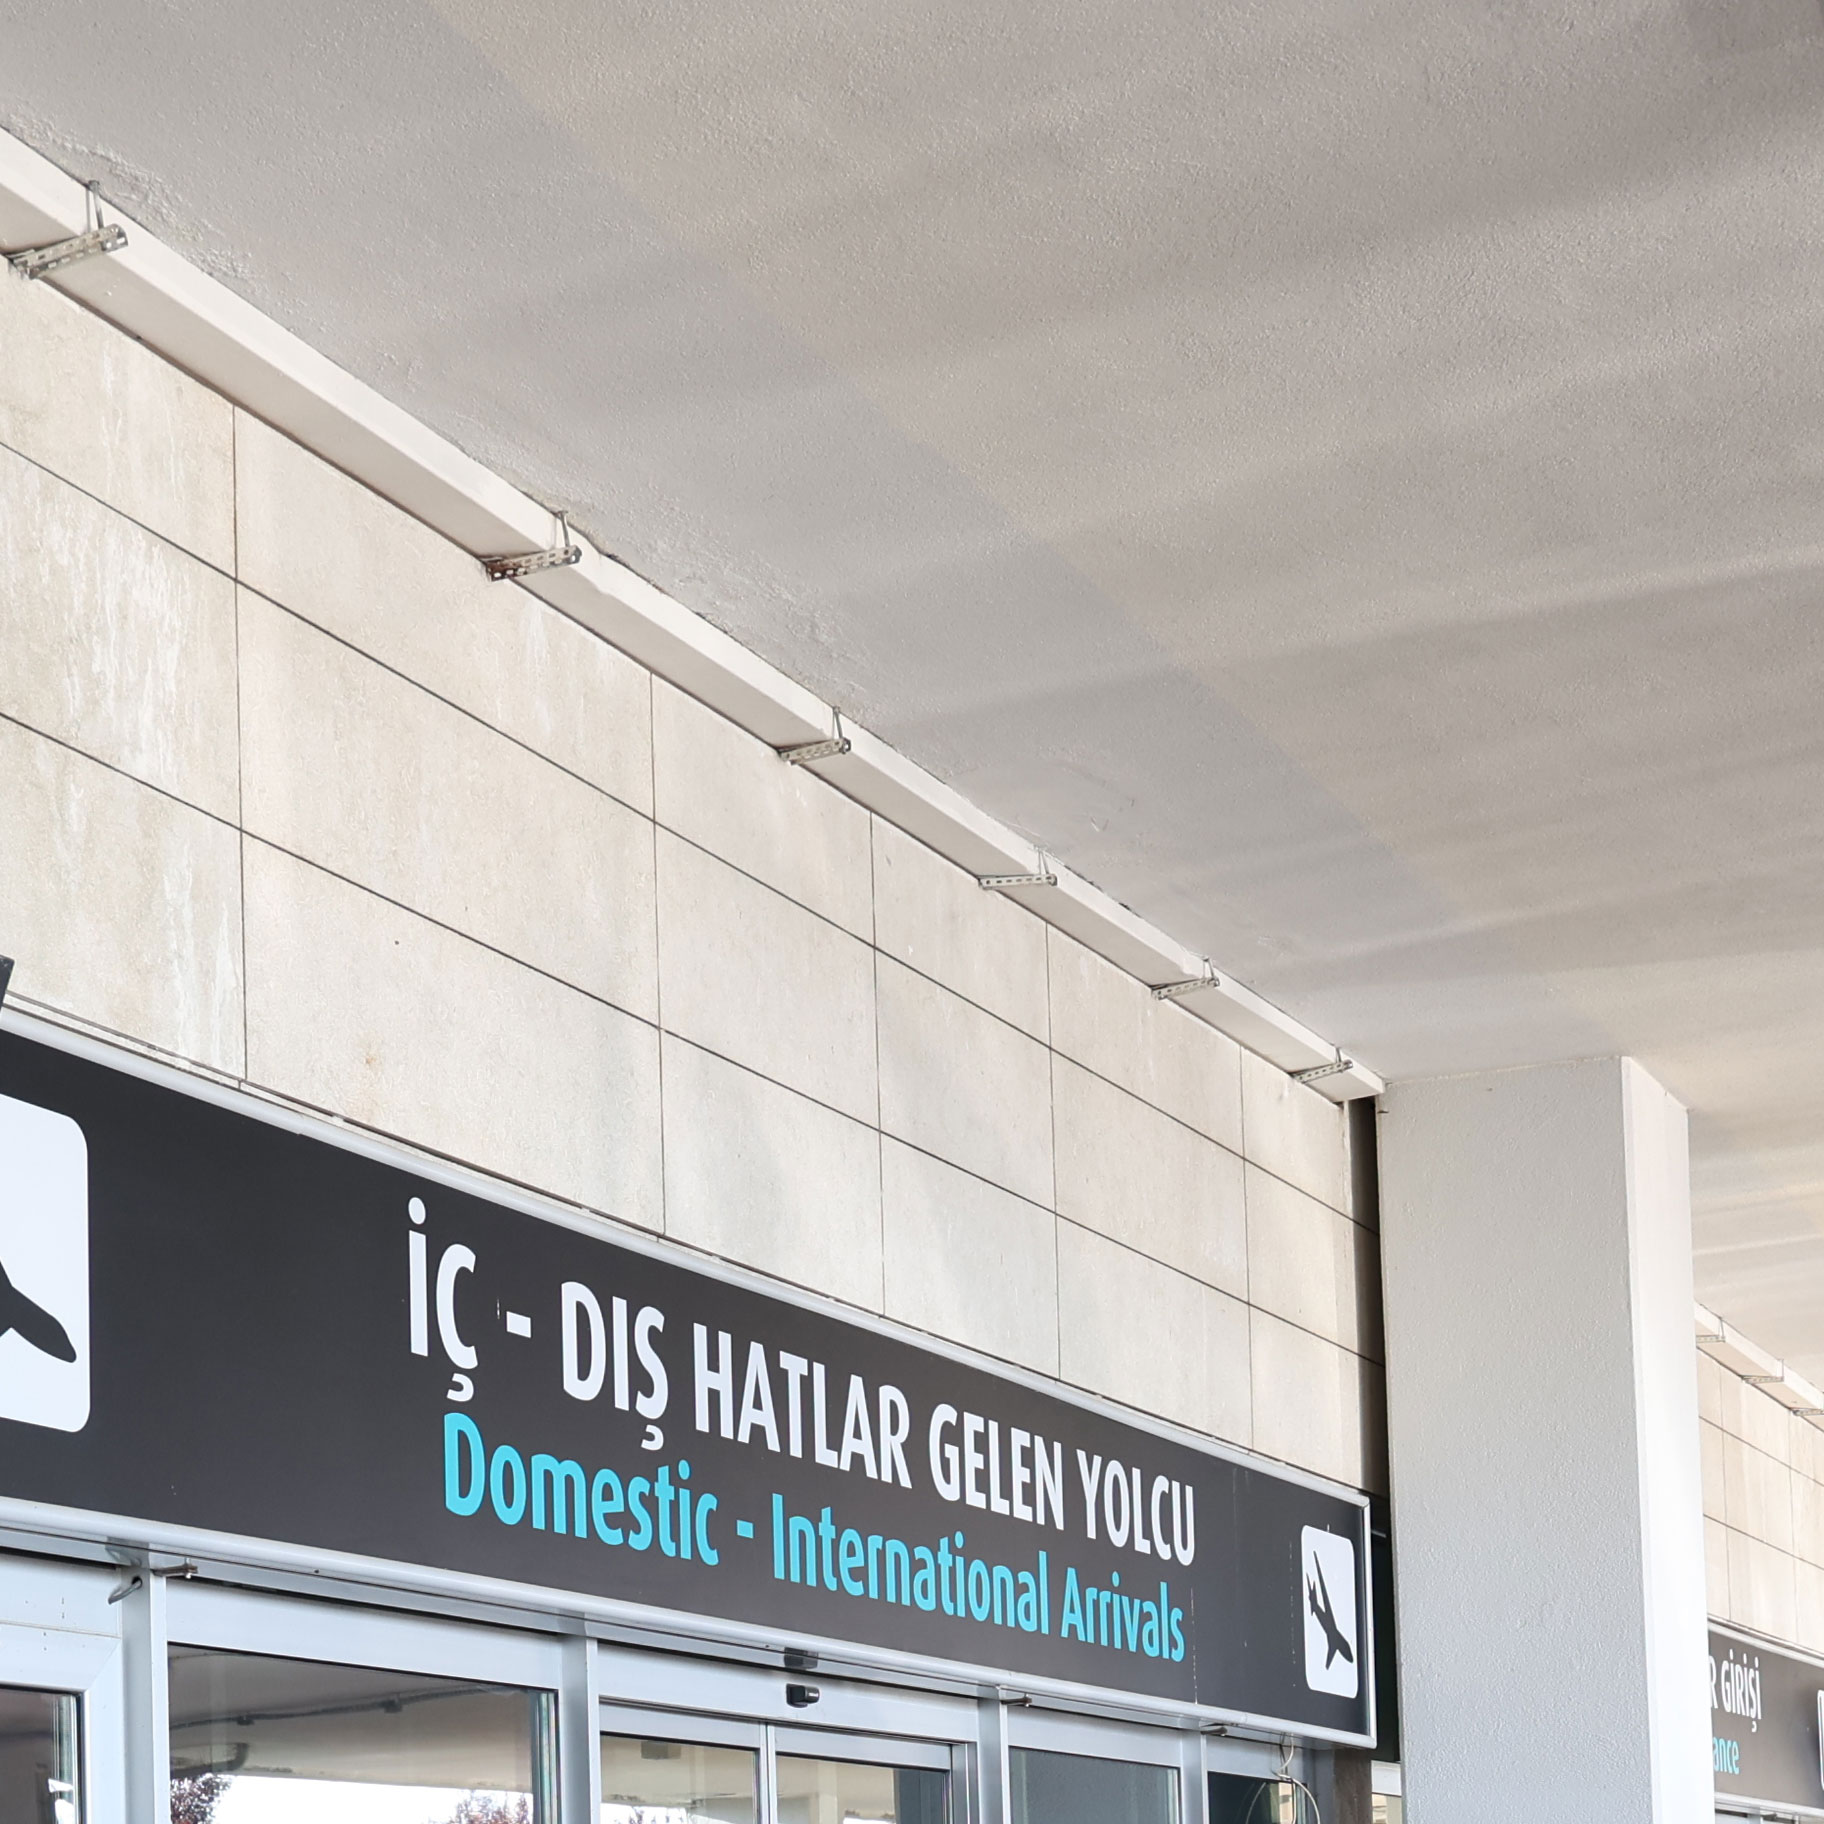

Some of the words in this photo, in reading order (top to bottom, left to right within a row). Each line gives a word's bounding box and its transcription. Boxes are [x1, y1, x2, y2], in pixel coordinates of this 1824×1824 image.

[408, 1197, 479, 1402] İÇ
[562, 1281, 668, 1451] DIŞ
[694, 1322, 913, 1489] HATLAR
[928, 1403, 1065, 1531] GELEN
[1076, 1448, 1195, 1567] YOLCU
[443, 1412, 720, 1566] Domestic
[773, 1493, 1051, 1634] International
[1060, 1567, 1186, 1663] Arrivals
[1713, 1737, 1739, 1775] ance
[1721, 1649, 1762, 1732] GİRİŞİ
